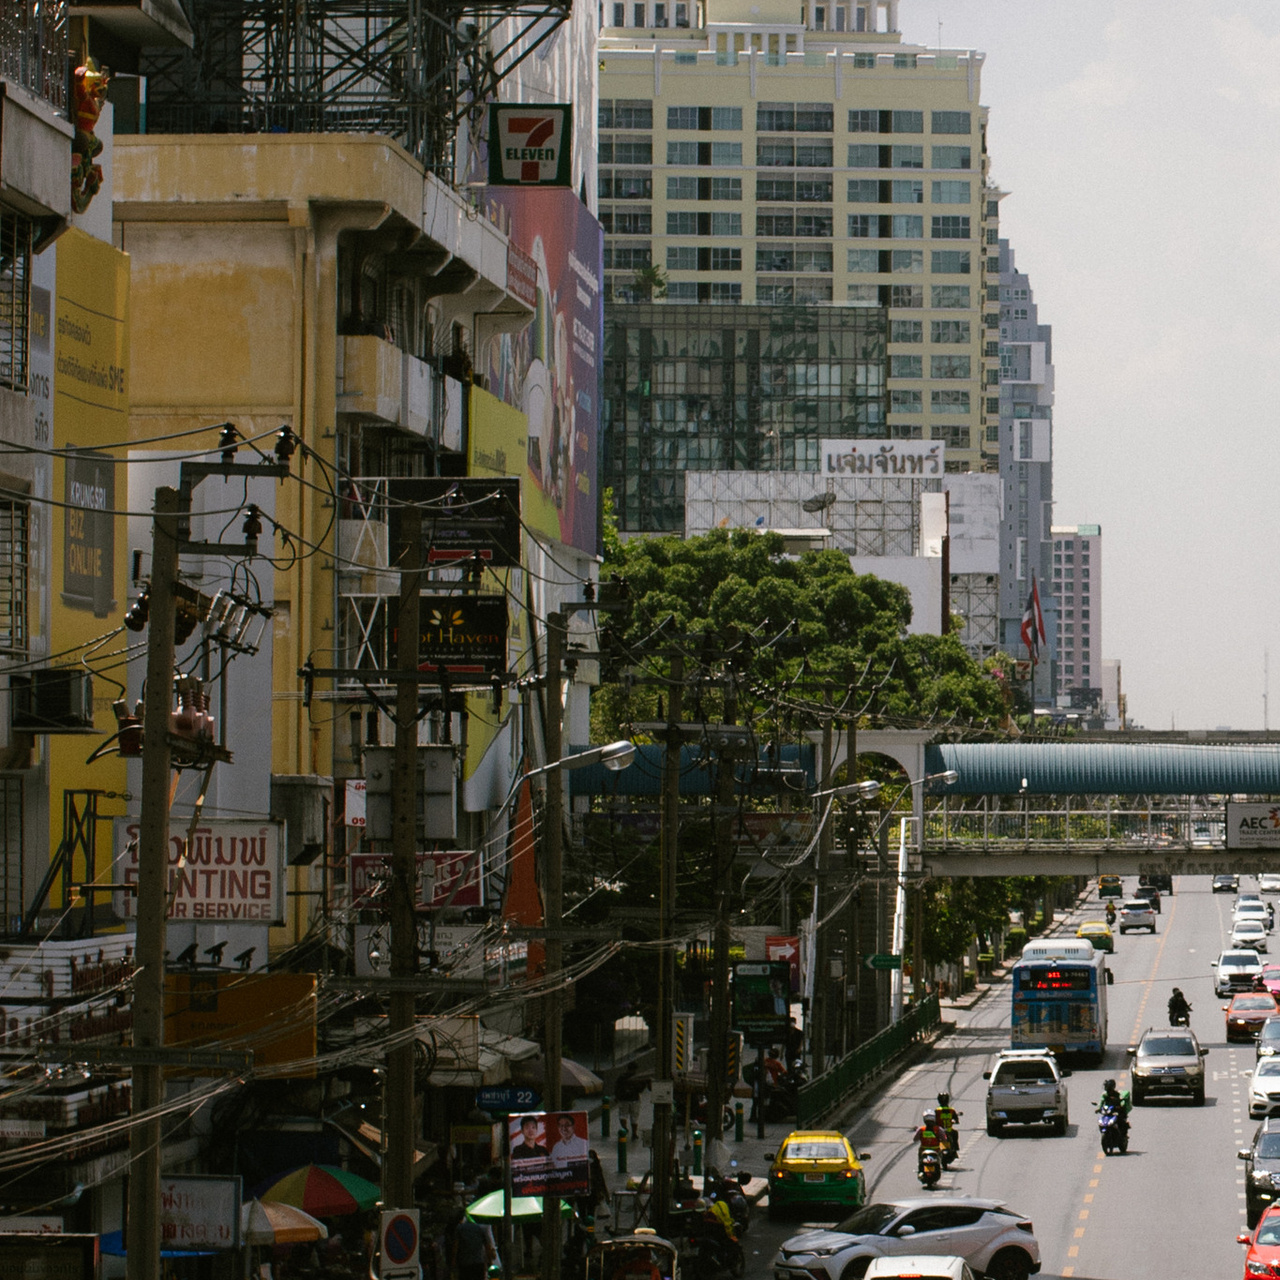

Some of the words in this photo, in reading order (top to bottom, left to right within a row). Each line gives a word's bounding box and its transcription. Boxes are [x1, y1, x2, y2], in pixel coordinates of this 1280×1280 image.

[828, 445, 939, 474] แจ่มจันทร์
[71, 481, 107, 510] KRUNGSRI
[70, 542, 102, 578] ONLINE
[439, 627, 499, 644] Haven
[1239, 816, 1268, 829] AEC
[126, 824, 270, 866] โงพิมพ์
[124, 868, 271, 899] PINTING
[193, 903, 271, 919] SERVICE
[517, 1091, 533, 1104] 22
